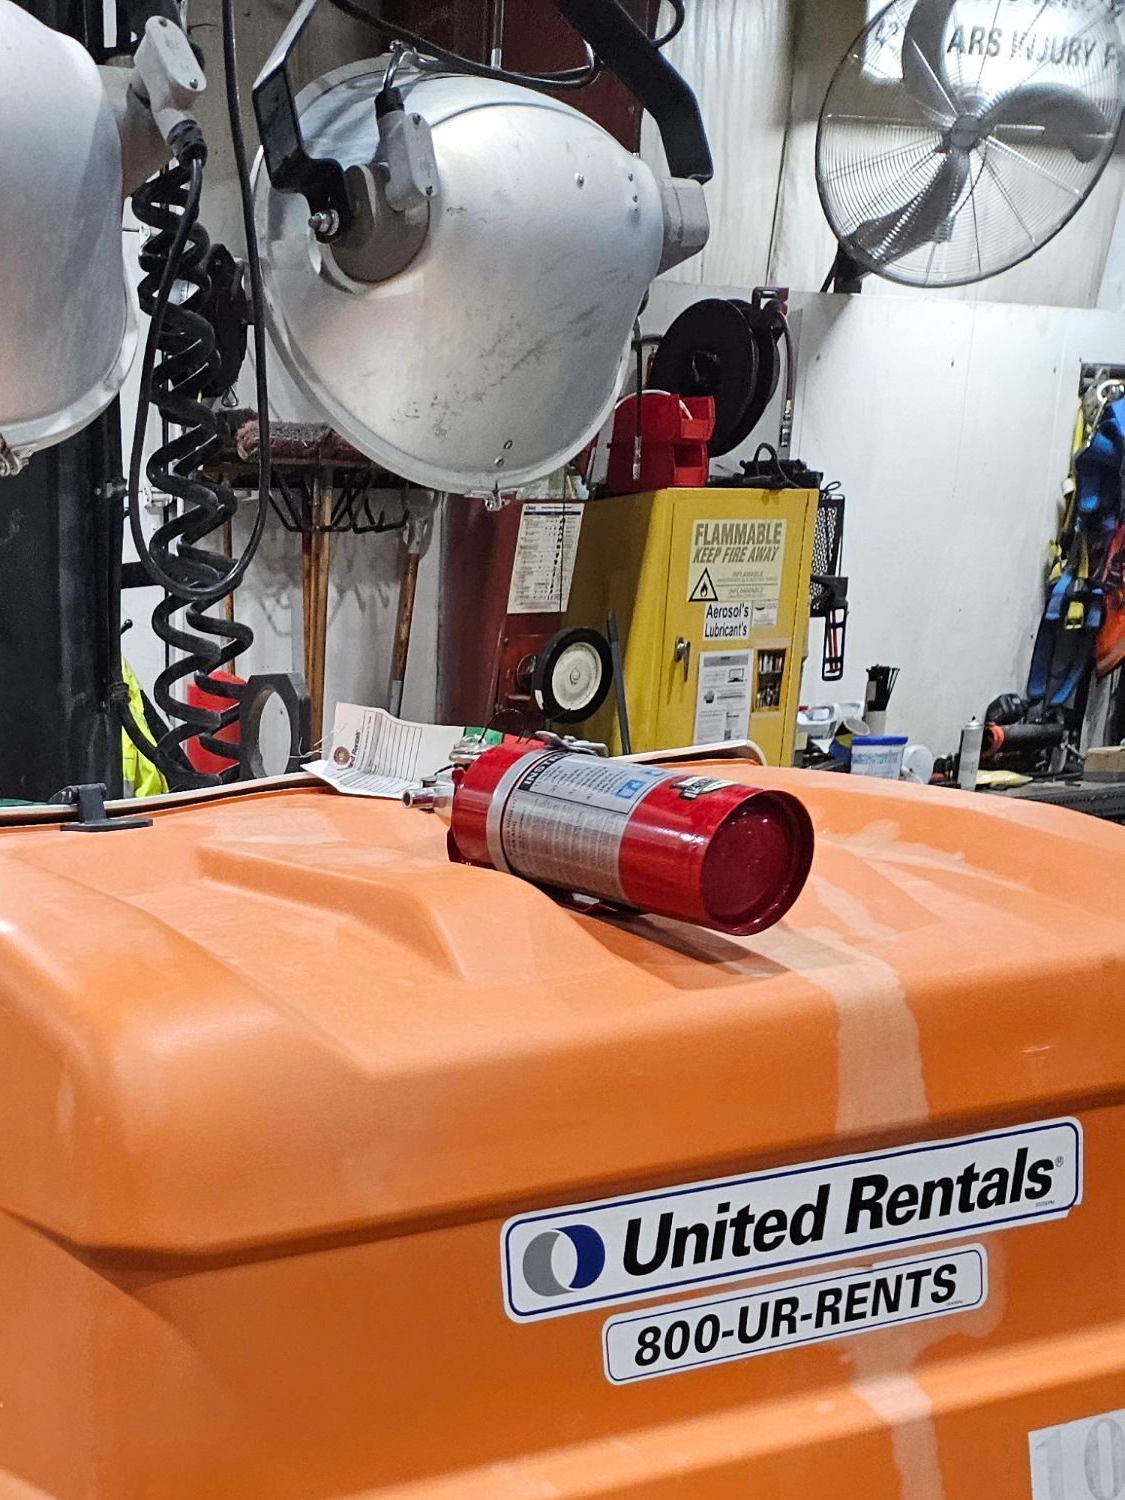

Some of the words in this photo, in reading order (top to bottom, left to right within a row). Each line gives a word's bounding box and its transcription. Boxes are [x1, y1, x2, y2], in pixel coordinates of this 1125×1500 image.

[947, 24, 1003, 57] ARS
[1011, 29, 1097, 66] INJURY
[694, 522, 782, 546] FLAMMABLE
[692, 547, 722, 564] KEEP
[722, 547, 748, 563] FIRE
[747, 546, 780, 562] AWAY
[706, 602, 749, 619] Aerosol's
[704, 622, 748, 638] Lubricant's
[622, 1183, 830, 1277] United
[844, 1146, 1055, 1235] Rentals
[634, 1263, 958, 1368] 800-UR-RENTS
